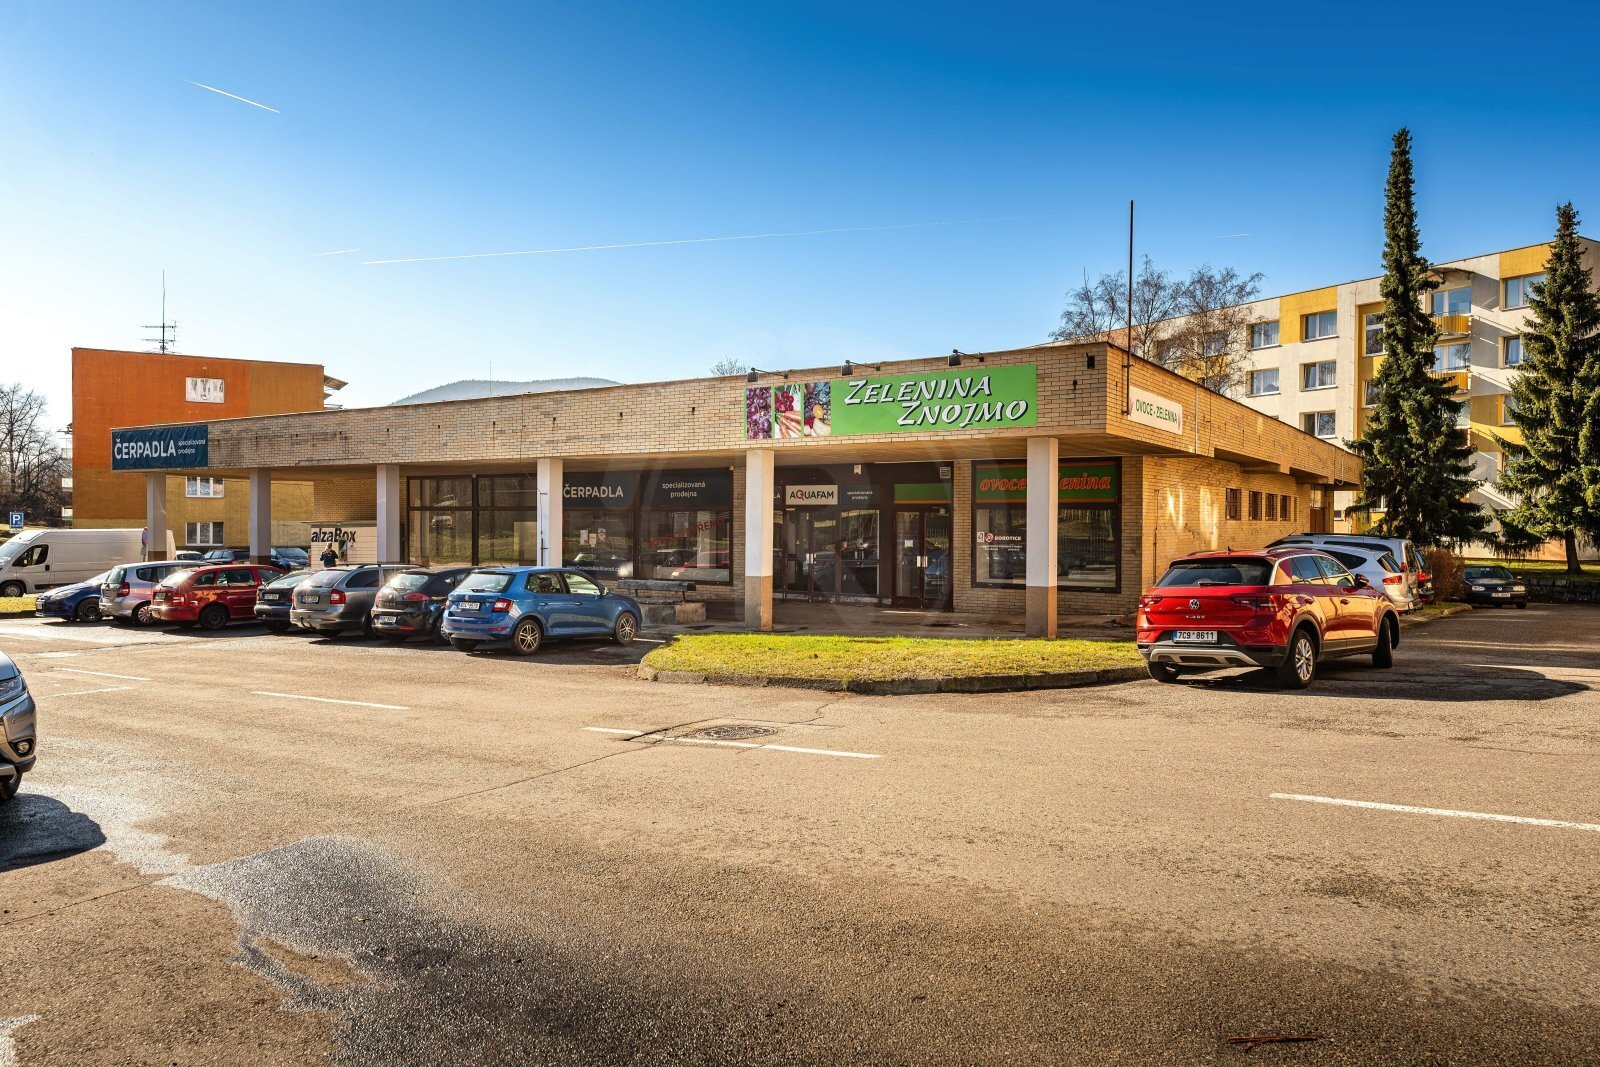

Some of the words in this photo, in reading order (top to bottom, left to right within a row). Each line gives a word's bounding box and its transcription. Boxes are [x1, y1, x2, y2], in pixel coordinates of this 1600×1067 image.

[844, 375, 992, 405] ZELENINA
[897, 400, 1028, 428] ZNOJMO
[1136, 398, 1153, 416] OVOCE
[1156, 406, 1178, 424] ZELENINA
[114, 438, 177, 460] ČERPADLA
[563, 483, 624, 498] ČERPADLA
[662, 481, 706, 489] specializovaná
[980, 478, 1027, 491] ovoce
[1057, 472, 1112, 490] enina
[670, 490, 698, 499] prodejna
[789, 489, 834, 501] AQUAFAM
[13, 514, 21, 524] P
[311, 527, 356, 542] alzaBox
